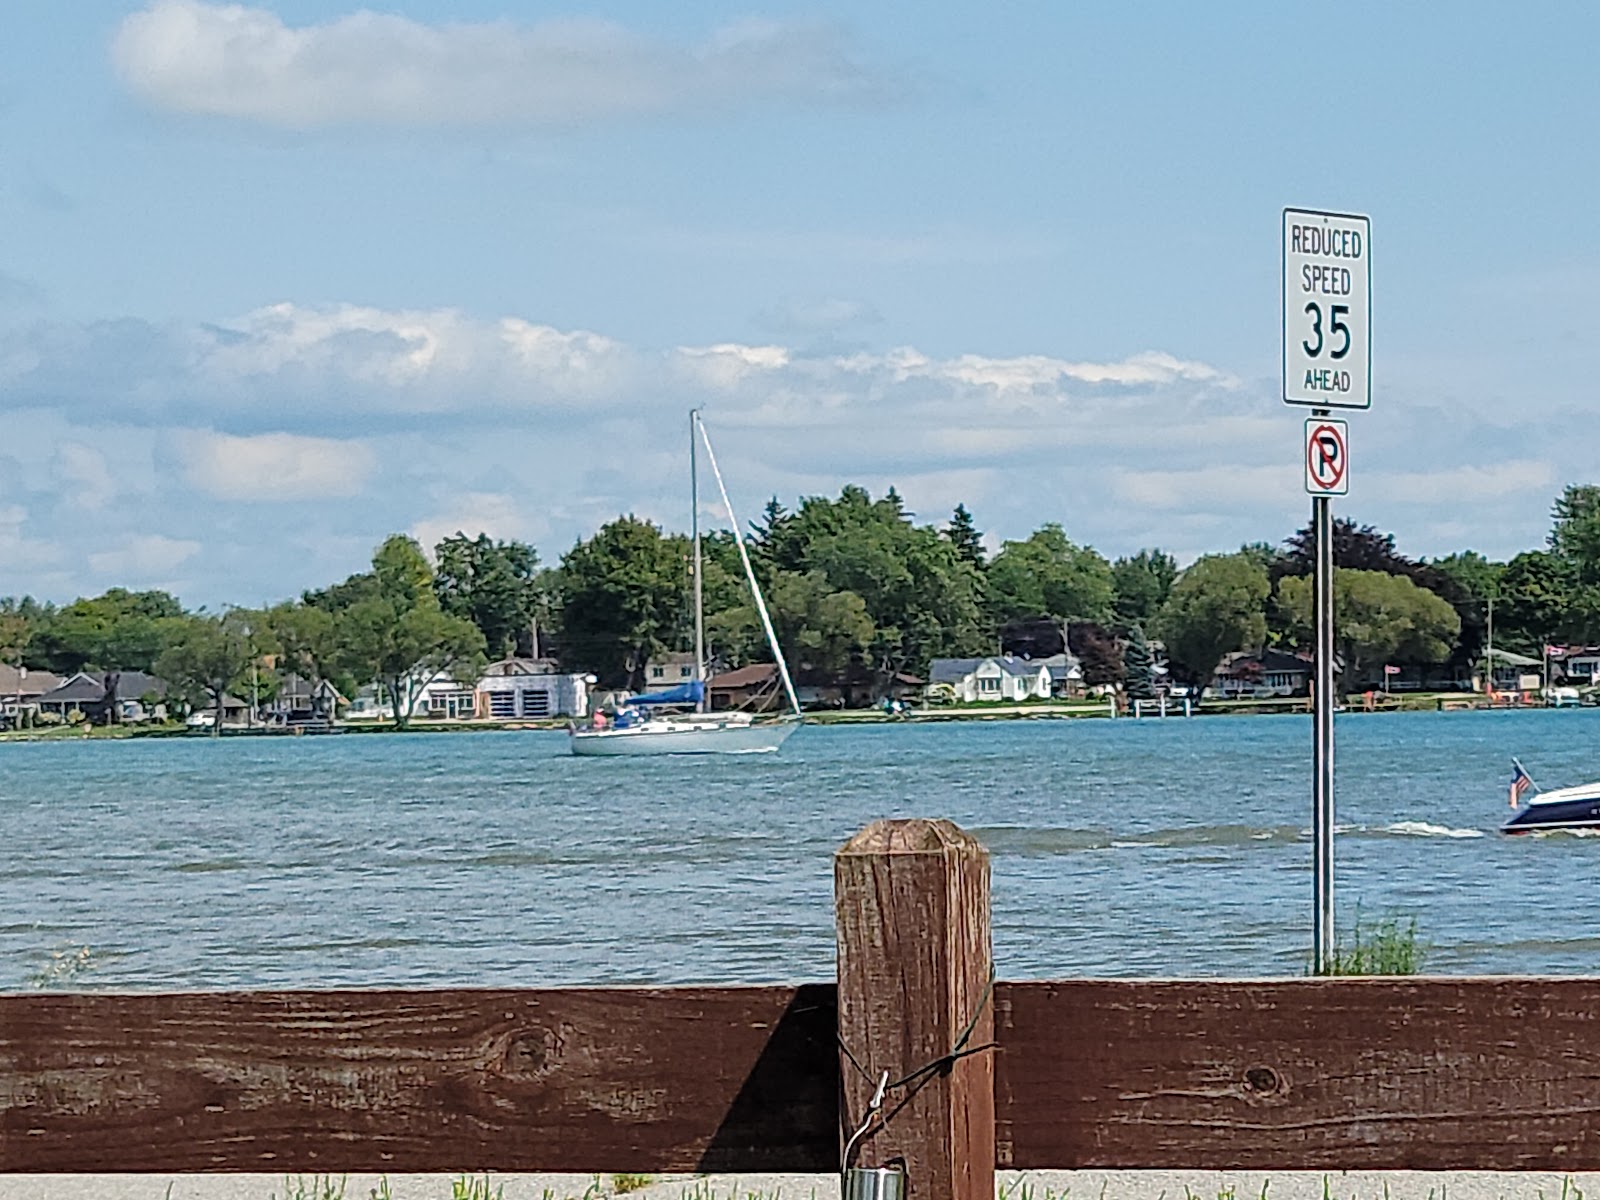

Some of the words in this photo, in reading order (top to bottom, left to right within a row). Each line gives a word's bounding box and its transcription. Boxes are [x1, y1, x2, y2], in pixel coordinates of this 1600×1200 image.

[1292, 225, 1361, 258] REDUCED
[1302, 264, 1350, 295] SPEED
[1303, 302, 1350, 359] 35
[1304, 369, 1350, 392] AHEAD
